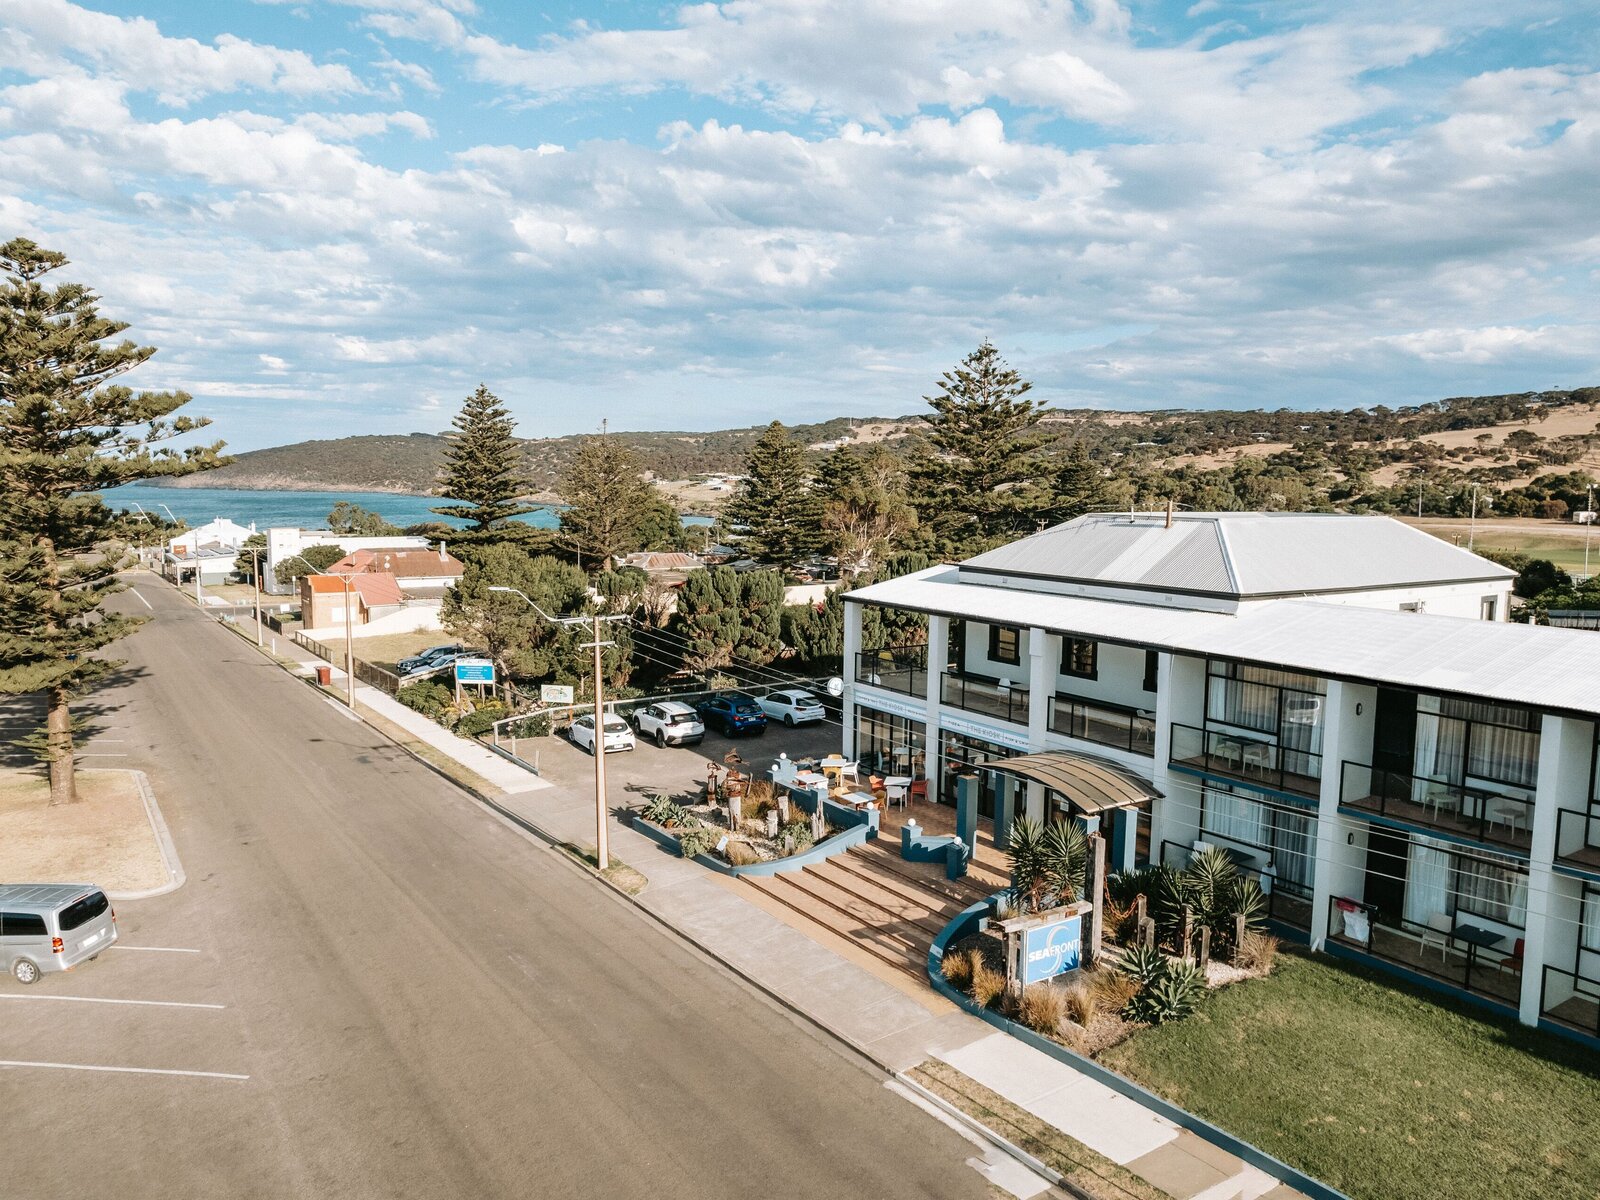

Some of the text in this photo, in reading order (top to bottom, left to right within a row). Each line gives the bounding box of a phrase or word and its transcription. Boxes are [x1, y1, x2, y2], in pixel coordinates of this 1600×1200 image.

[970, 724, 1001, 740] THE KIOSK
[1028, 938, 1079, 963] SEAFRONT
